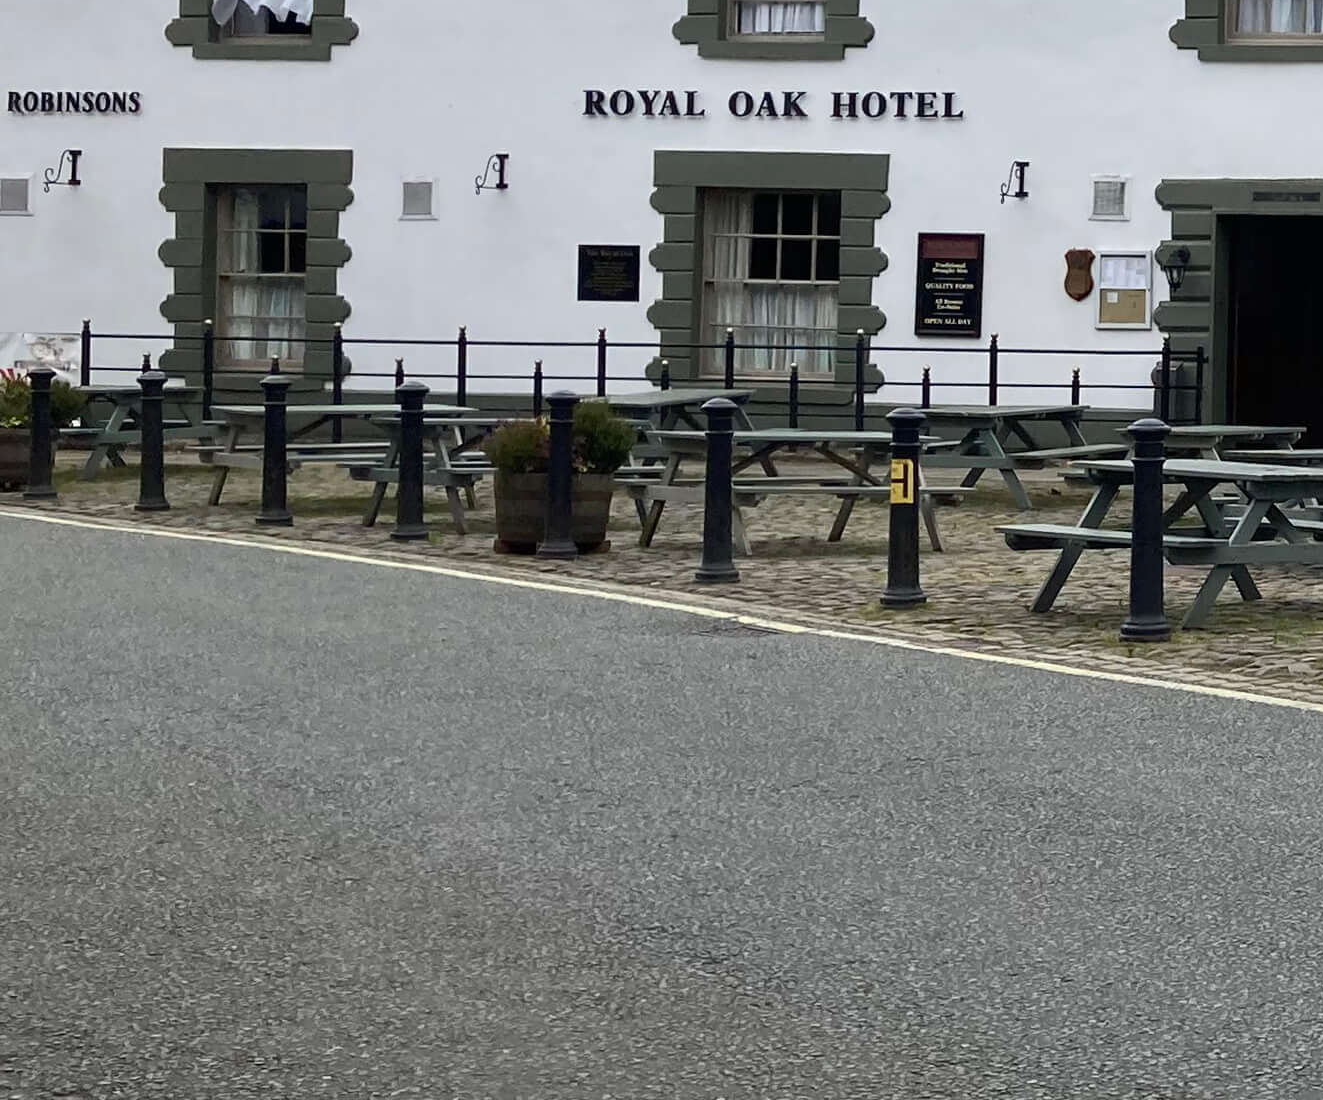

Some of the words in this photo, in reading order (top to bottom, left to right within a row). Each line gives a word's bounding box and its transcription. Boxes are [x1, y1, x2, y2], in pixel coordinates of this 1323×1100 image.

[7, 90, 141, 115] ROBINSONS
[581, 89, 706, 117] ROYAL
[727, 90, 809, 118] OAK
[829, 91, 964, 119] HOTEL
[925, 282, 954, 290] QUALITY
[924, 317, 943, 325] OPEN
